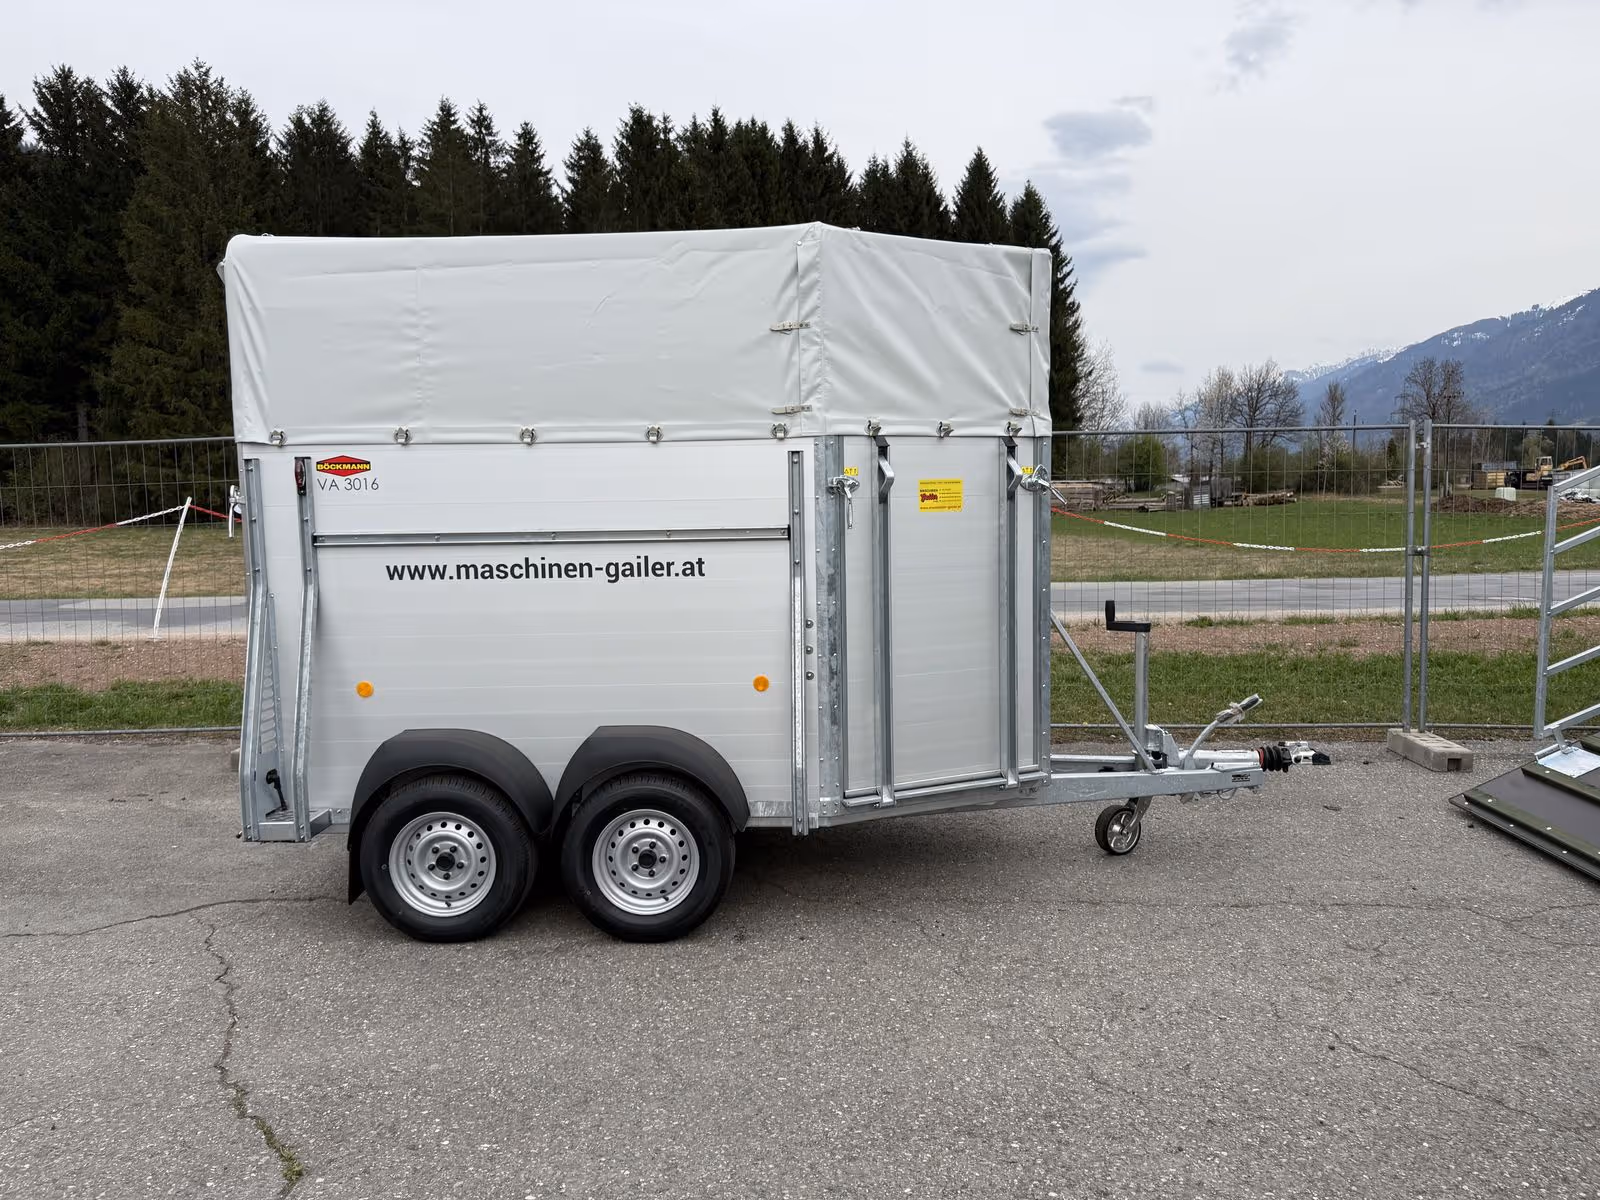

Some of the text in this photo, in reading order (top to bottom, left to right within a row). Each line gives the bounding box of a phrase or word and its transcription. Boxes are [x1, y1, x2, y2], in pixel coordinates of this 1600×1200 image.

[317, 462, 370, 470] BÖCKMANN
[317, 477, 379, 491] VA 3016
[385, 555, 706, 584] www.maschinen-gailer.at
